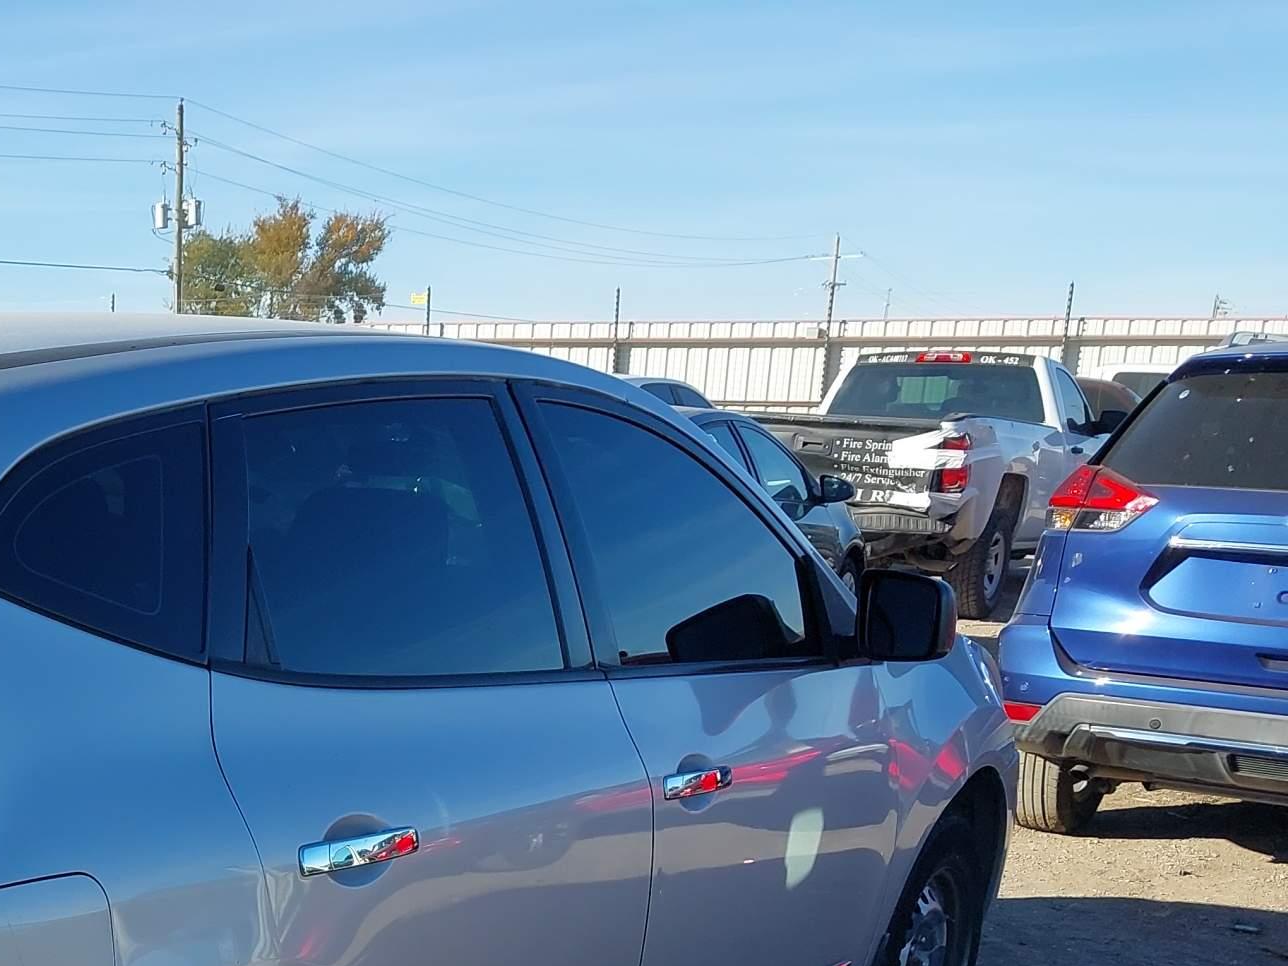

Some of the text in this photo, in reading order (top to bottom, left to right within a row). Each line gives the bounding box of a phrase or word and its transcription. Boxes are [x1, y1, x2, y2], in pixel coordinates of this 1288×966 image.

[842, 438, 892, 452] Fire Sprin
[840, 451, 861, 462] Fire
[840, 463, 926, 477] Fire Extinguisher
[840, 472, 863, 483] 24/7
